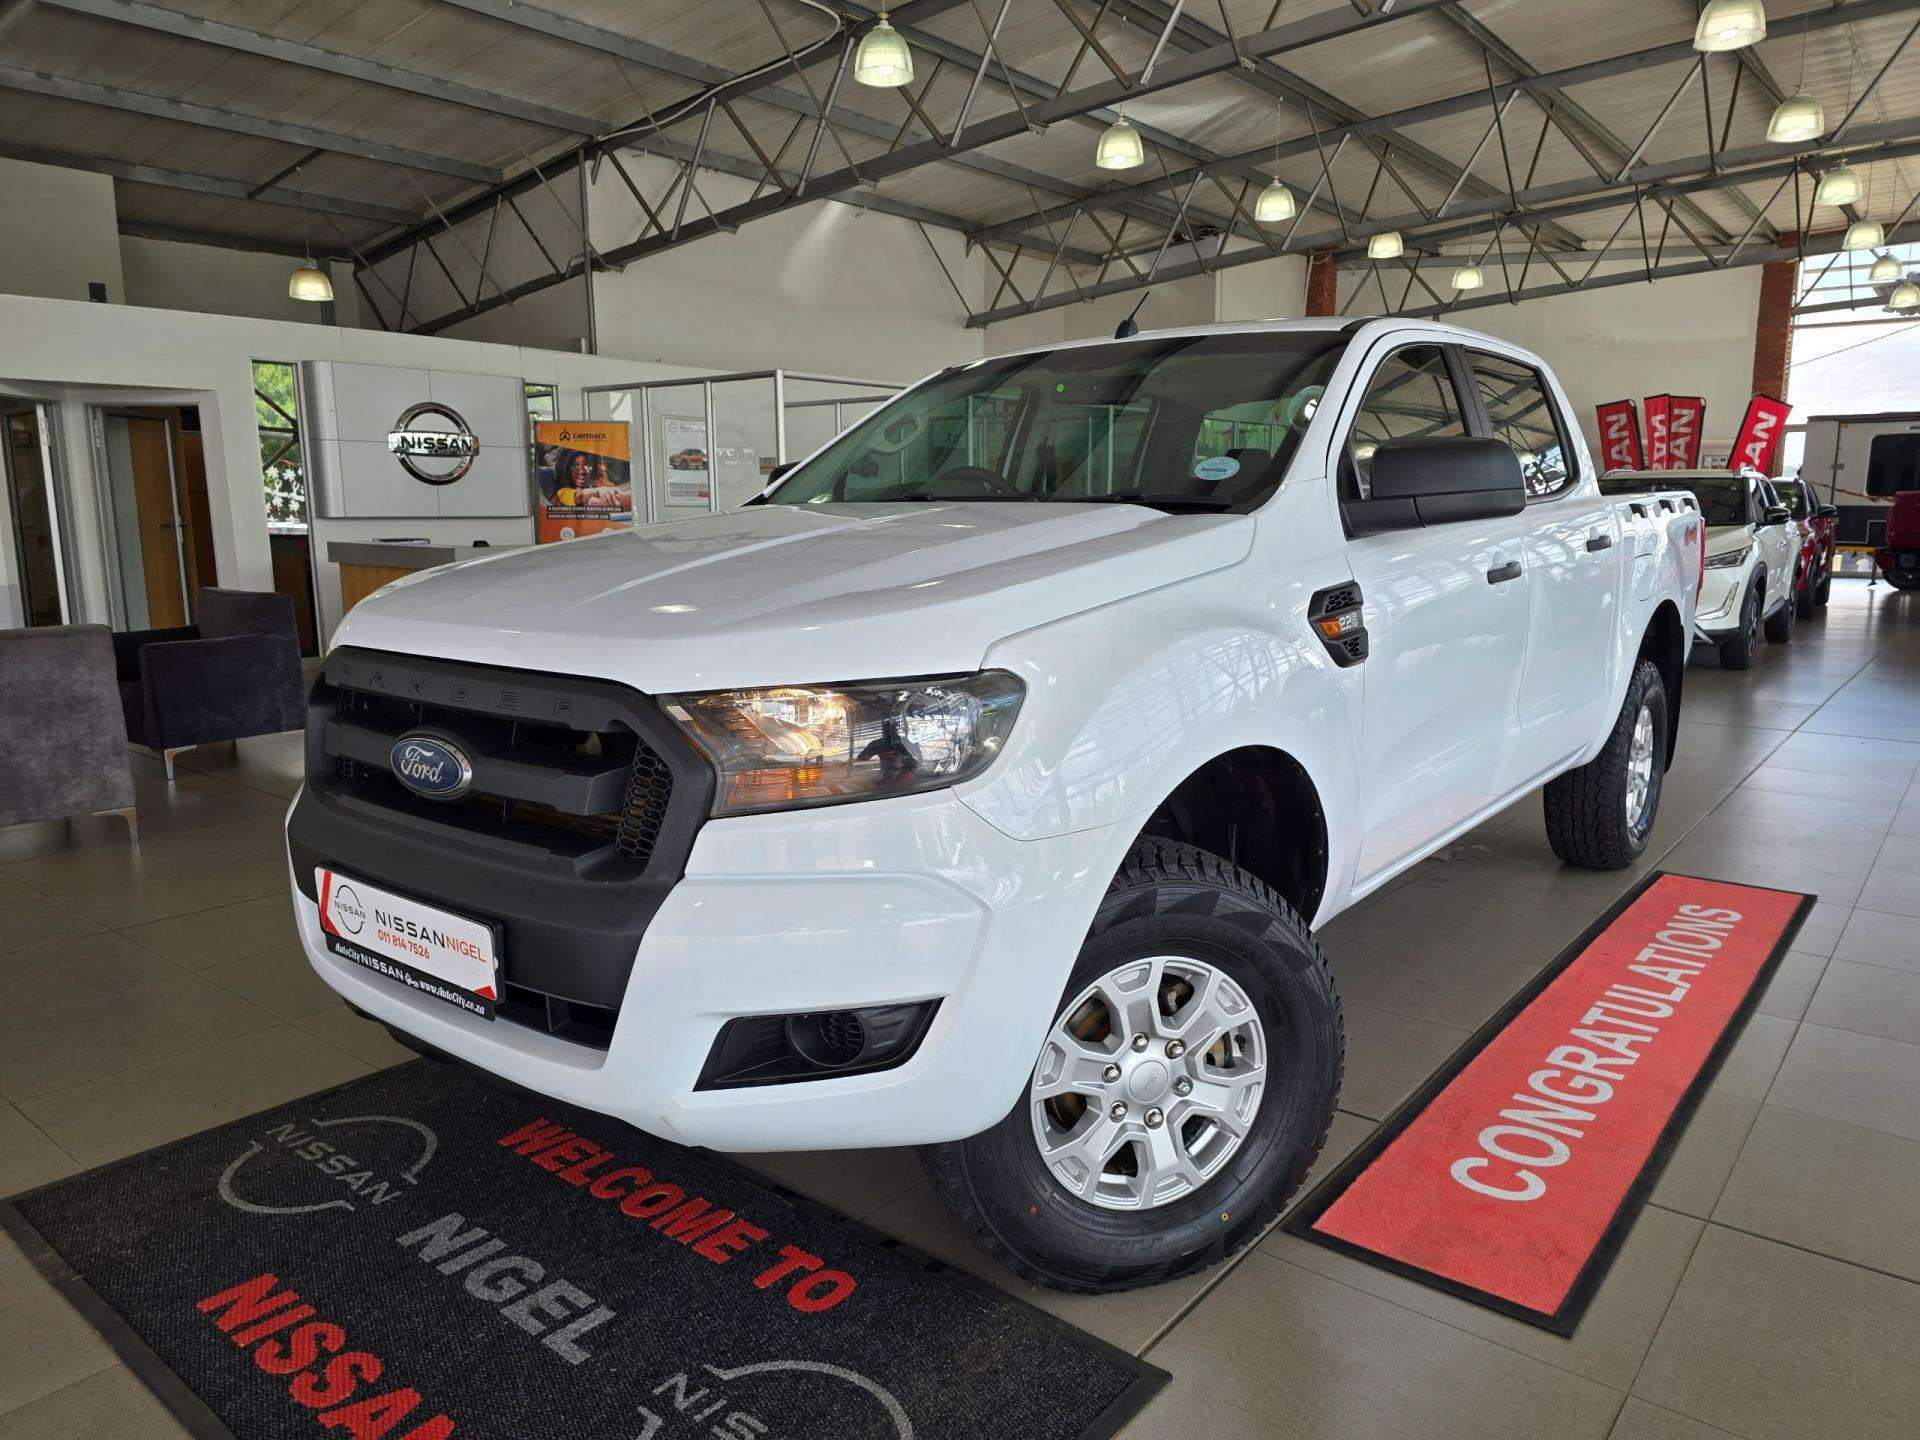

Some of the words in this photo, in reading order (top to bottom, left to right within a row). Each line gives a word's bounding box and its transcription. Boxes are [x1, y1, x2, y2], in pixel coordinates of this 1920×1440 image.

[400, 435, 472, 451] NISSAN
[572, 432, 608, 440] CARTRACK
[1740, 411, 1777, 468] AN
[401, 746, 444, 783] Ford
[334, 900, 366, 919] NISSAN
[377, 929, 391, 945] 011
[392, 934, 407, 951] 814
[408, 940, 431, 960] 7526
[335, 942, 361, 964] AutoCity
[361, 954, 403, 980] NISSAN
[419, 980, 485, 1015] www.AutoCity.co.za
[1450, 904, 1743, 1201] CONGRATULATIONS
[266, 1122, 401, 1206] NISSAN
[500, 1117, 770, 1265] WELCOME
[754, 1243, 858, 1313] TO
[396, 1212, 617, 1365] NIGEL
